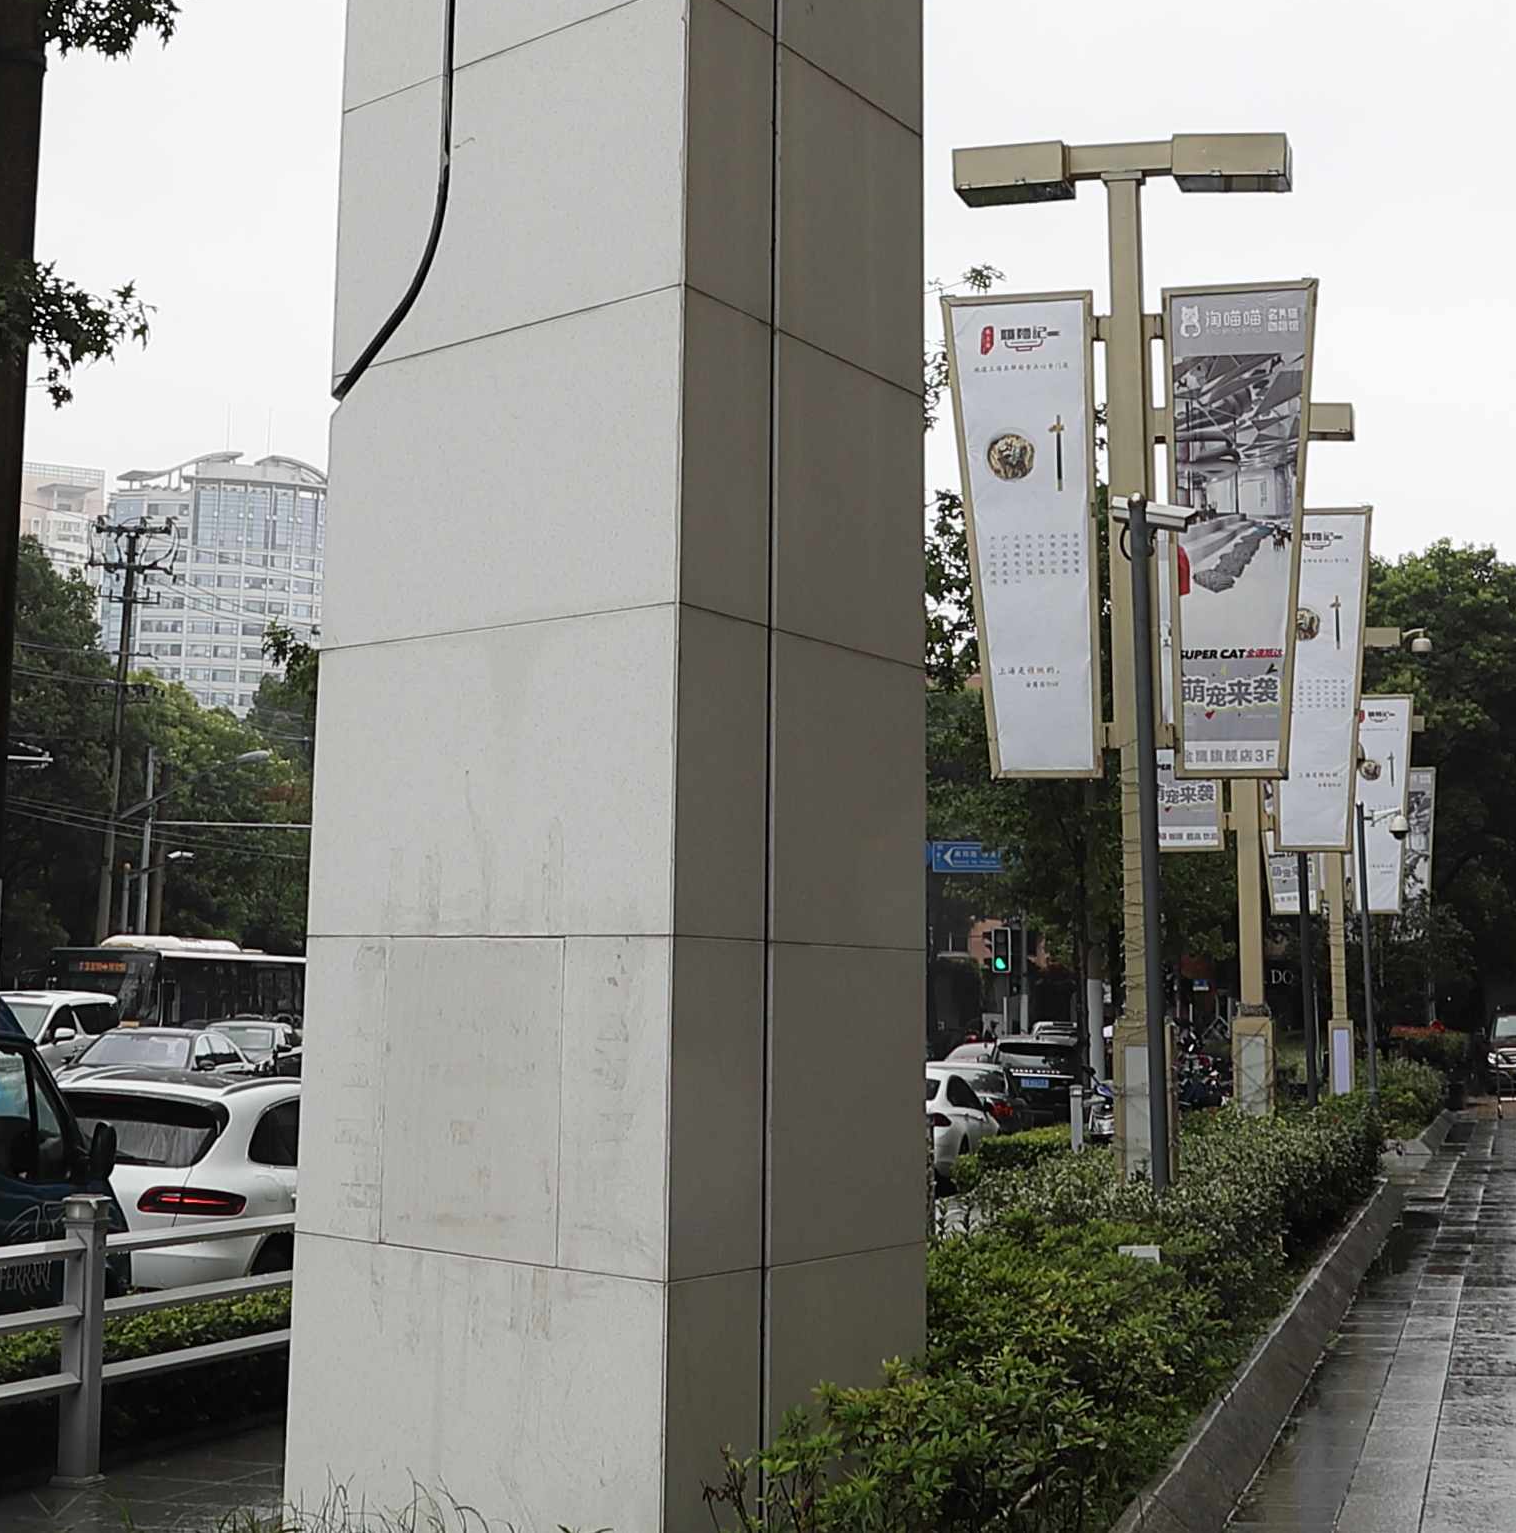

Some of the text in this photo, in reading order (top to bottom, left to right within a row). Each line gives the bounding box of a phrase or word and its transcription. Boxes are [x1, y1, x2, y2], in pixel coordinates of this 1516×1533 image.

[1220, 648, 1246, 659] CAT
[1182, 677, 1279, 707] 萌宠来袭
